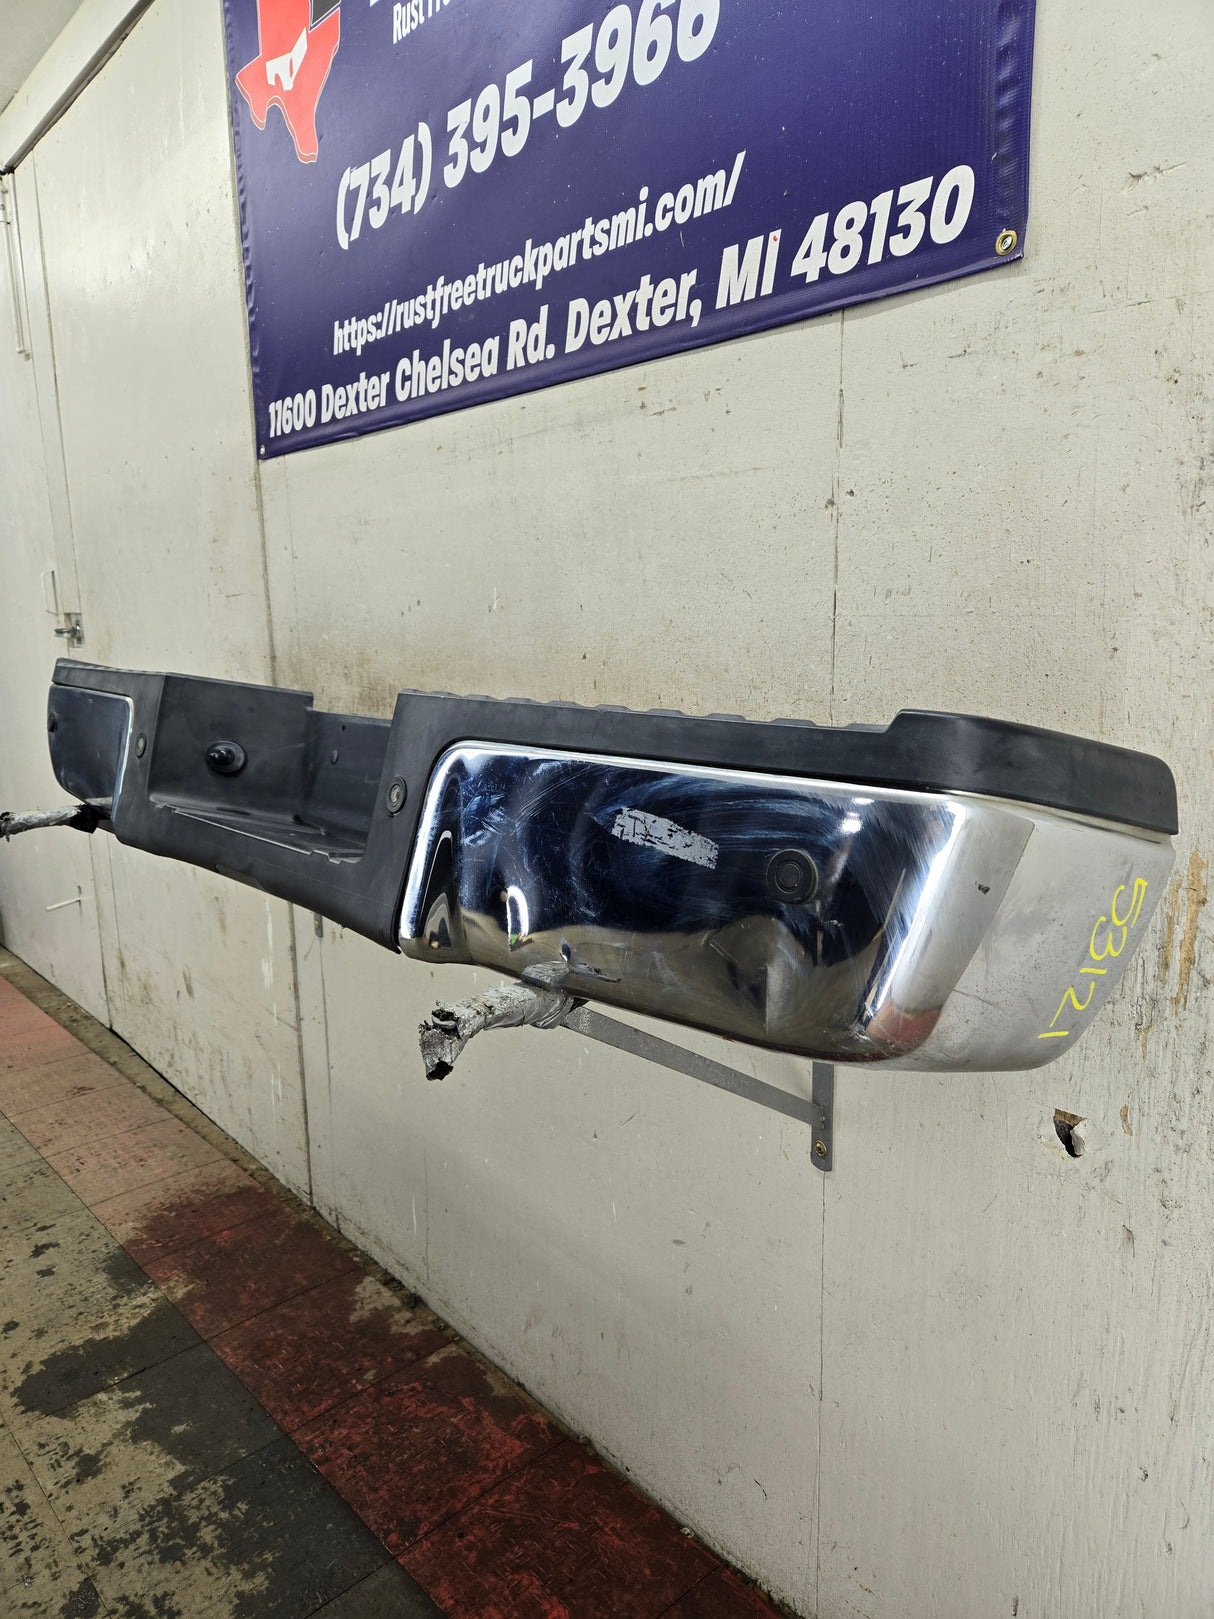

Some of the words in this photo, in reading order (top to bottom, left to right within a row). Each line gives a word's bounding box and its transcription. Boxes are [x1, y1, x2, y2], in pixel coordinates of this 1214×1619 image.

[336, 121, 433, 251] (734)
[443, 0, 721, 189] 395-3966
[392, 0, 425, 45] Rust
[268, 388, 317, 438] 11600
[320, 371, 390, 424] Dexter
[395, 338, 501, 402] Chelsea
[506, 303, 556, 371] Rd.
[564, 268, 702, 354] Dexter,
[715, 228, 782, 310] MI
[790, 164, 975, 284] 48130
[333, 150, 747, 356] https://rustfreetruckpartsmi.com/
